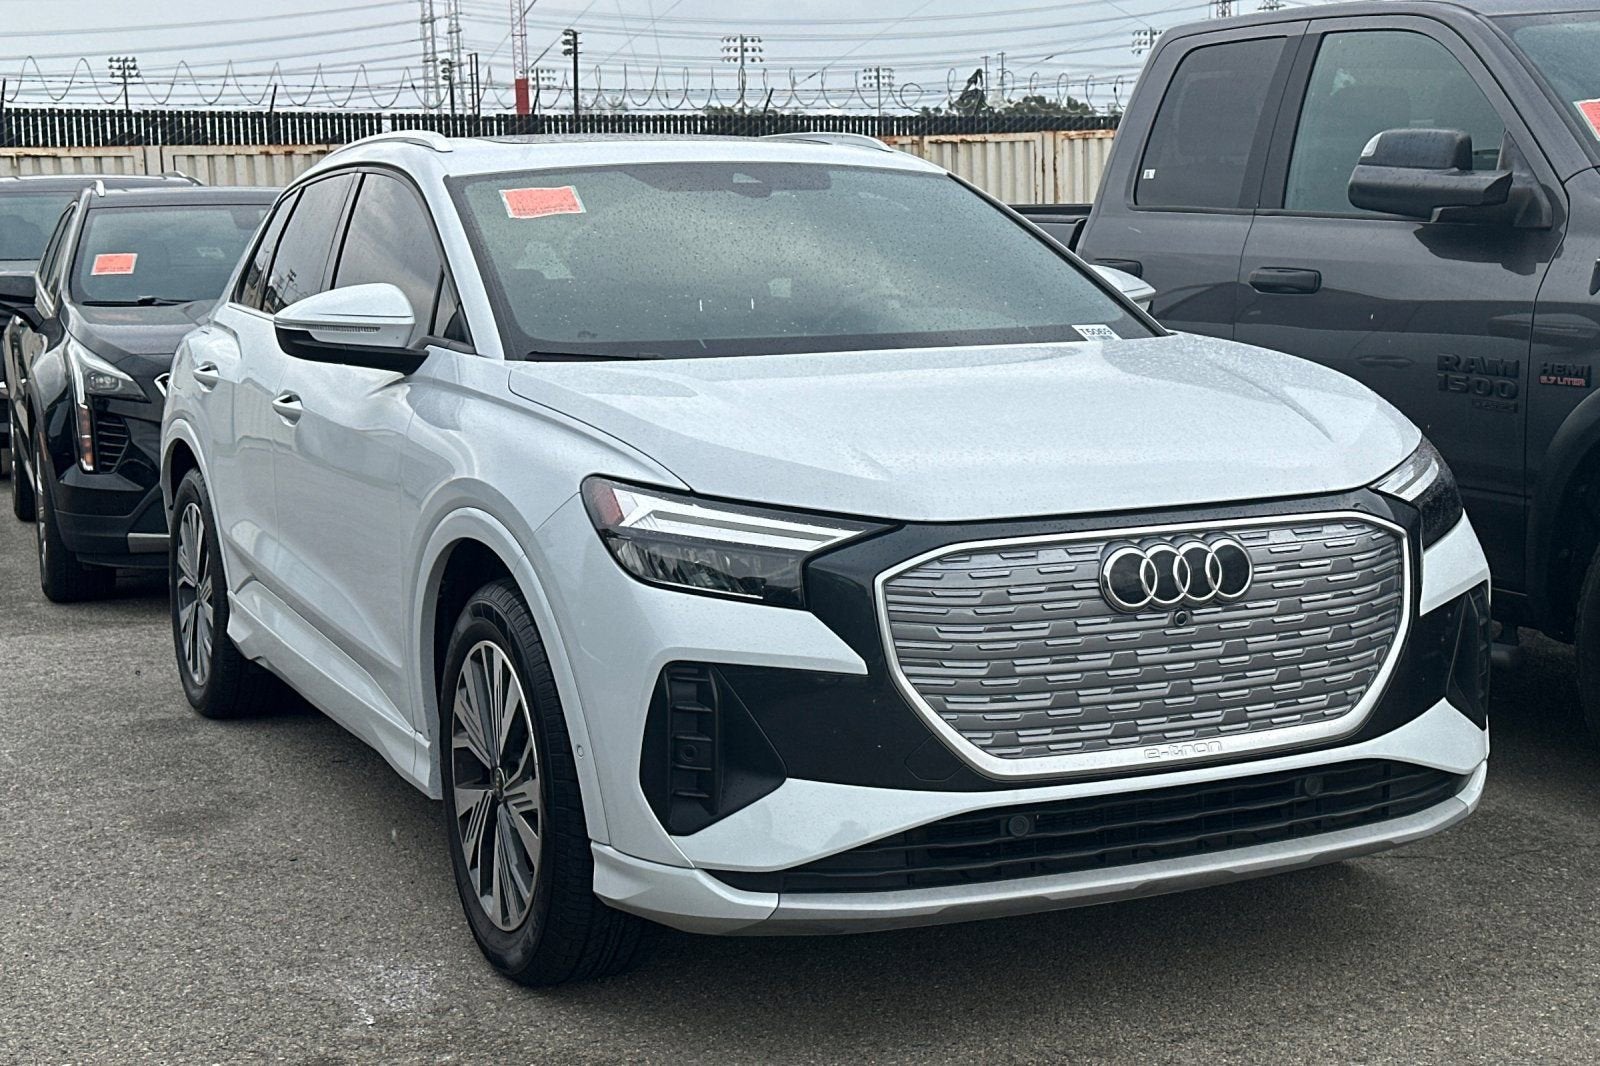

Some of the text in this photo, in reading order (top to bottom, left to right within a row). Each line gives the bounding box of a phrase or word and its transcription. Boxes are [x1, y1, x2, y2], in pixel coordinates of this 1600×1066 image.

[1437, 353, 1519, 378] RAM
[1541, 362, 1591, 376] HEMI
[1437, 373, 1519, 399] 1500
[1557, 376, 1586, 386] LITER
[1144, 741, 1222, 759] e-tron
